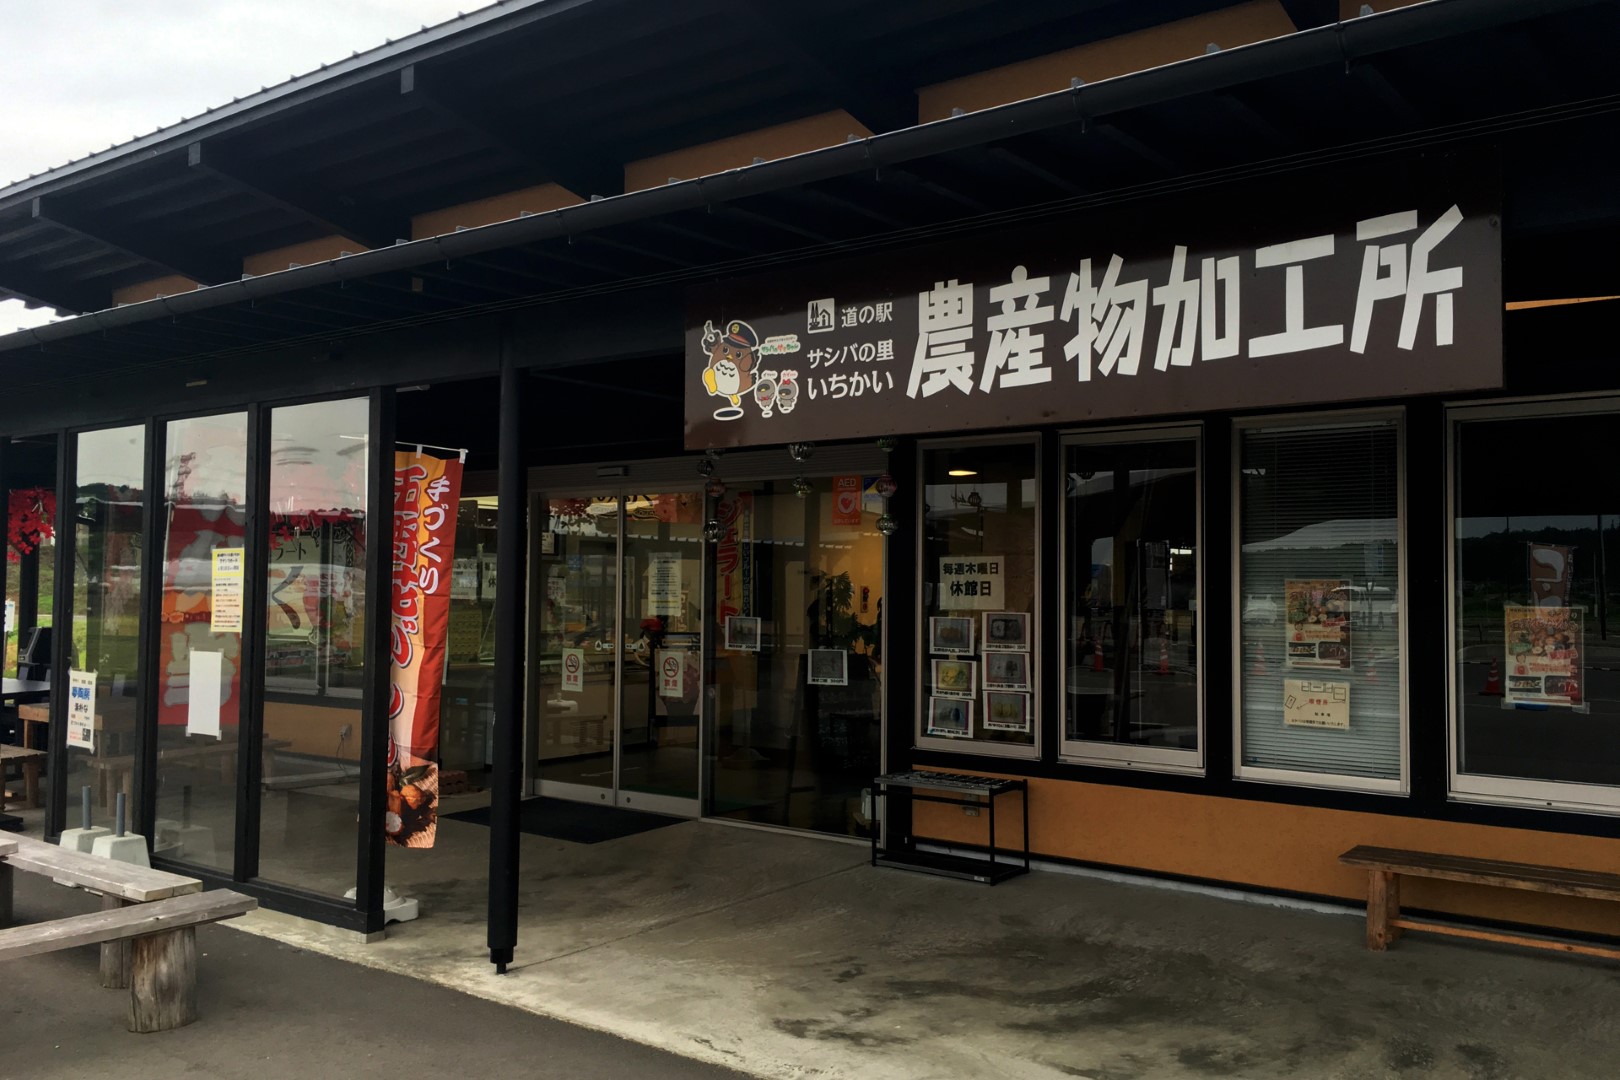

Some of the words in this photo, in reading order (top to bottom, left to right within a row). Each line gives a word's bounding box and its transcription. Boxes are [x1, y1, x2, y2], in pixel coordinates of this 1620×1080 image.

[841, 301, 893, 328] 道の駅
[906, 205, 1464, 399] 農産物加工所
[807, 339, 894, 369] サシバの里
[807, 370, 894, 400] いちかい
[837, 478, 857, 488] AED
[419, 475, 450, 595] 手づくり
[943, 562, 999, 575] 毎週木曜日
[950, 580, 991, 596] 休館日
